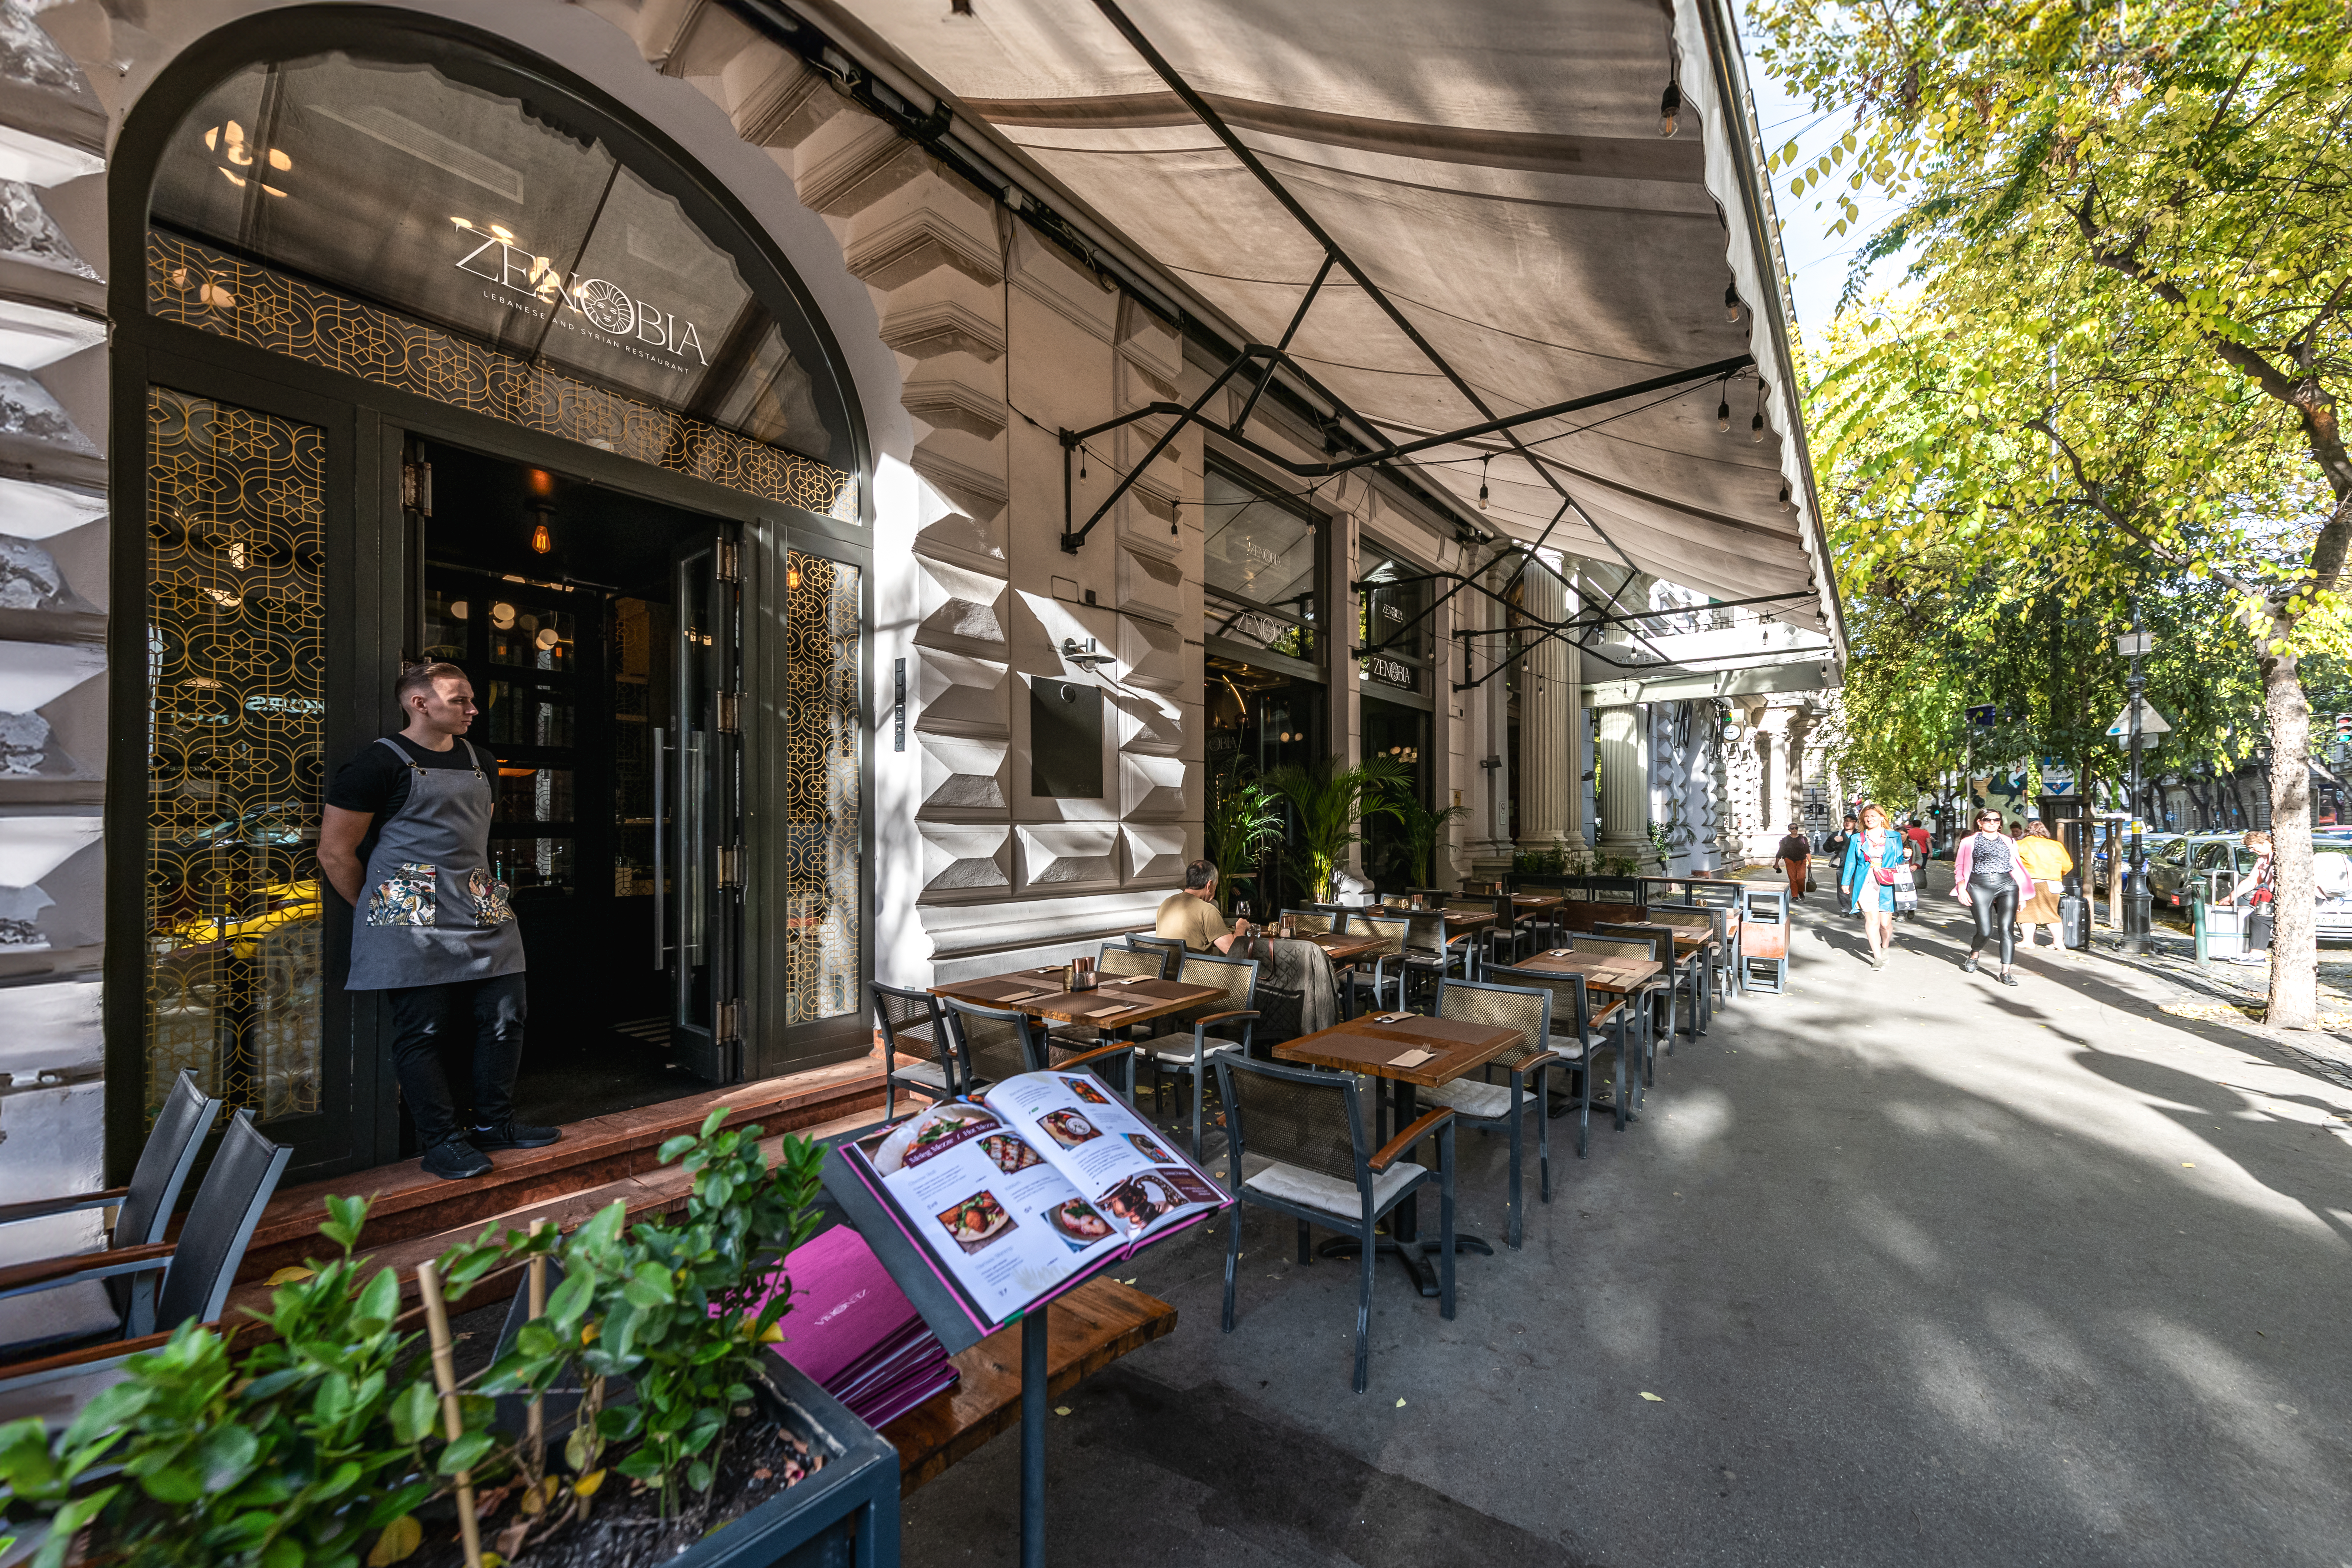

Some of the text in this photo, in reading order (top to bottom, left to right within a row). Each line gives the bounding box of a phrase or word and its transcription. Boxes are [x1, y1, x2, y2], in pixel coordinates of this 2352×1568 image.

[455, 223, 708, 366] ZENOBIA
[484, 290, 689, 374] LEBANESE AND SYRIAN RESTAURANT
[1250, 543, 1281, 567] ZENOBIA
[1383, 604, 1403, 620] ZENOBIA
[1236, 610, 1293, 646] ZENOBIA
[1374, 658, 1410, 684] ZENOBIA
[1616, 654, 1656, 663] HOTEL
[909, 1149, 933, 1164] Meleg
[930, 1137, 955, 1152] Mezze
[962, 1127, 977, 1137] Hot
[975, 1122, 996, 1132] Mezze
